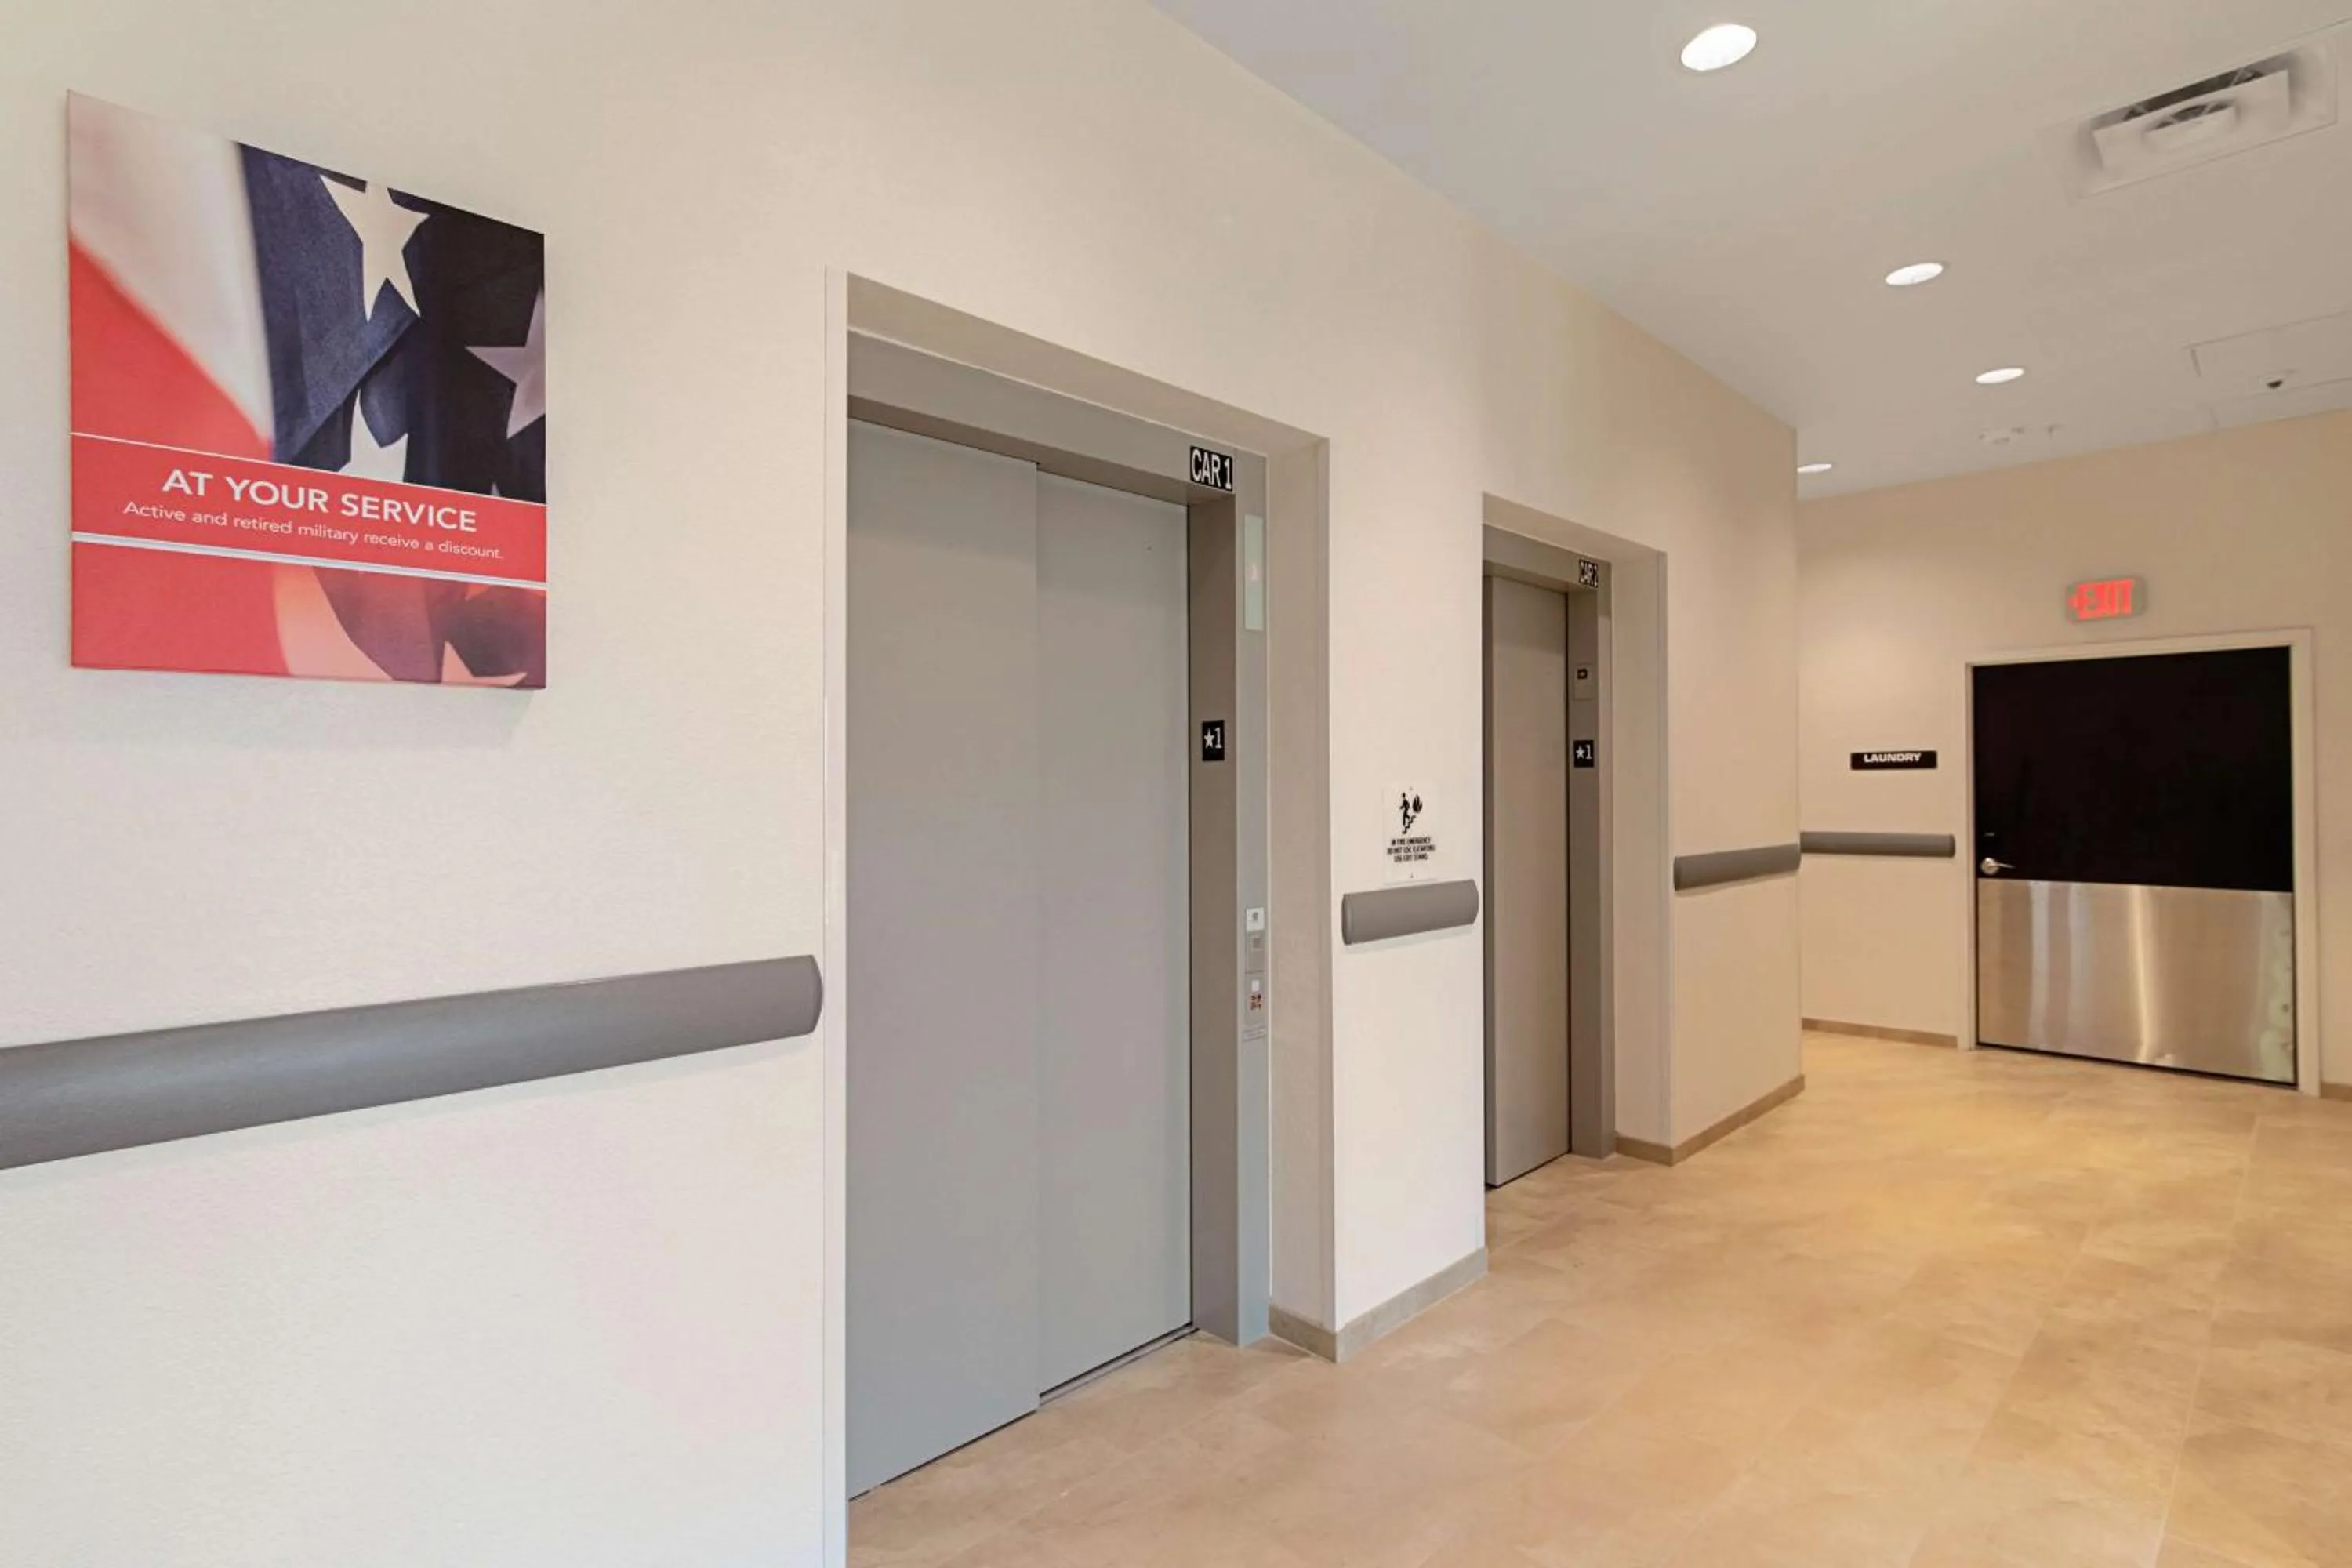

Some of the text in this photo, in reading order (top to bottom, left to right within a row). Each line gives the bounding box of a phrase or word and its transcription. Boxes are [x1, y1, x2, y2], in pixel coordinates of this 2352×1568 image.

[1192, 448, 1232, 490] CAR 1
[162, 469, 477, 533] AT YOUR SERVICE
[124, 501, 503, 560] Active and retired military receive a discount.
[2078, 579, 2133, 619] EXIT
[1864, 752, 1922, 764] LAUNDRY
